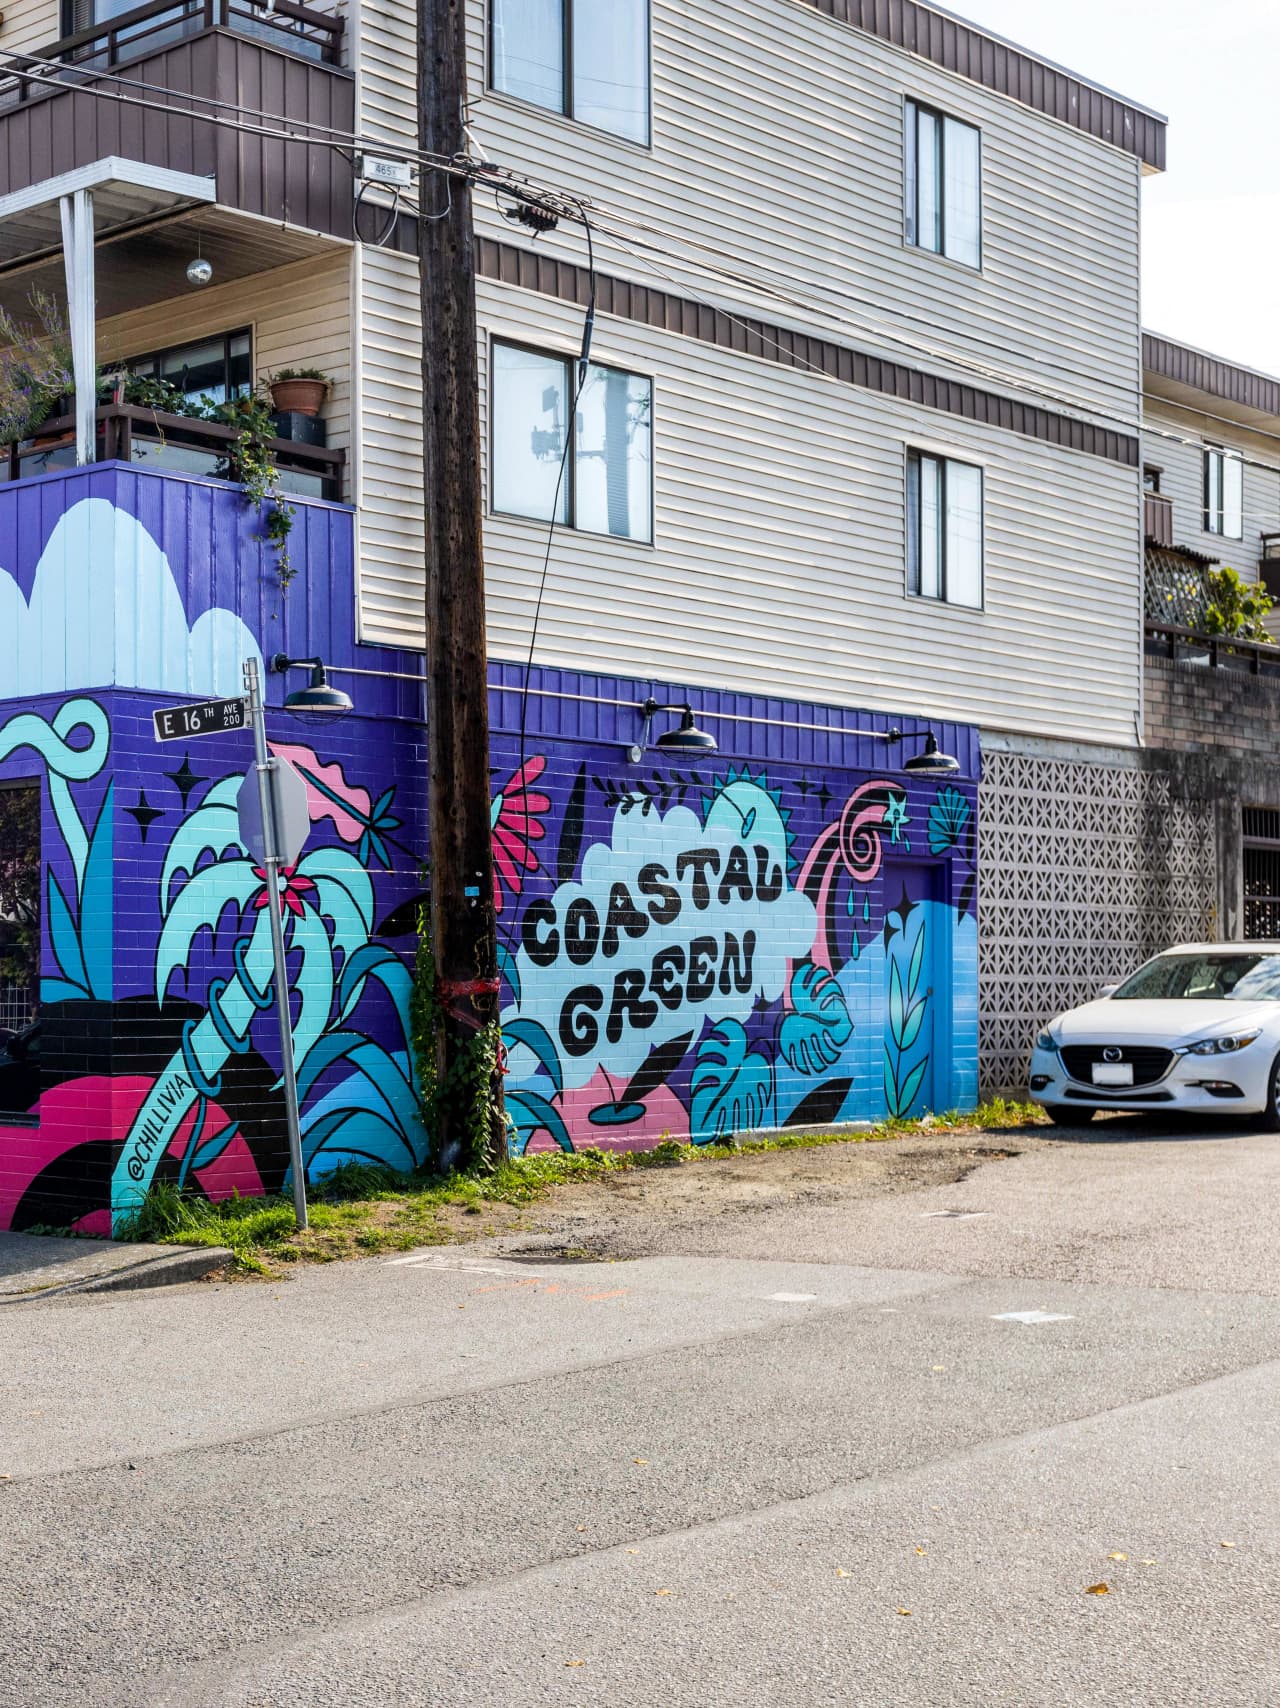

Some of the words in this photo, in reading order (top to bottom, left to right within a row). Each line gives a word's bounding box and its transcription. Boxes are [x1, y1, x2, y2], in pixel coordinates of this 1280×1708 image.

[163, 714, 175, 735] E
[183, 710, 200, 731] 16
[204, 706, 215, 718] TH
[223, 703, 238, 715] AVE
[223, 714, 240, 726] 200
[522, 844, 784, 967] COASTAL
[559, 930, 756, 1057] GREEN
[127, 1073, 192, 1182] @CHILLIVIA
